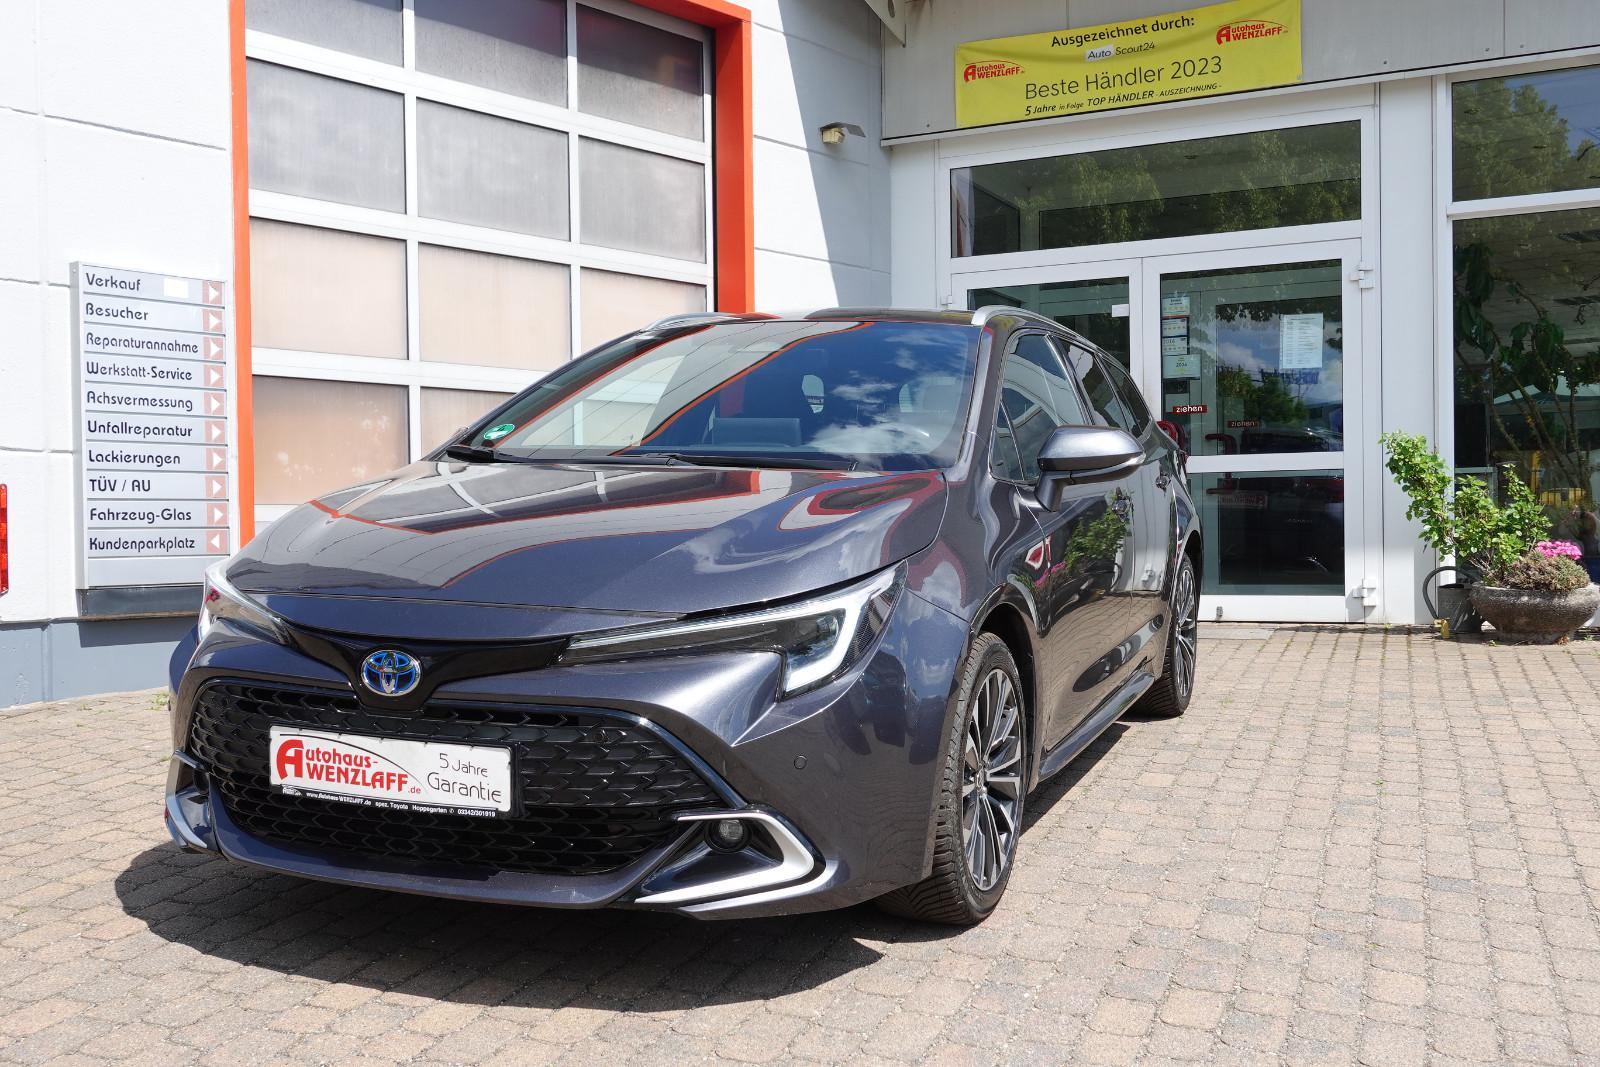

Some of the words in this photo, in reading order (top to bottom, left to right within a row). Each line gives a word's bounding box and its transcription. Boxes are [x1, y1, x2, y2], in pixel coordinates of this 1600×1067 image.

[1051, 23, 1148, 47] Ausgezeichnet
[1151, 15, 1195, 32] durch:
[1216, 23, 1265, 46] Autohaus
[1231, 26, 1283, 41] WENZLAFF
[1087, 49, 1112, 60] Auto
[1115, 41, 1156, 56] Scout24
[964, 63, 1006, 83] Autohaus
[977, 66, 1021, 79] WENZLAFF
[1025, 79, 1080, 100] Beste
[1085, 66, 1165, 92] Händler
[1170, 55, 1222, 80] 2023
[1025, 105, 1032, 117] 5
[1033, 103, 1057, 114] Jahre
[1059, 103, 1066, 111] in
[1066, 101, 1084, 110] Folge
[1087, 97, 1107, 107] TOP
[1108, 90, 1155, 104] HÄNDLER
[1159, 82, 1218, 97] AUSZEICHNUNG
[85, 272, 141, 291] Verkauf
[85, 302, 149, 320] Besucher
[86, 332, 199, 354] Reparaturannahme
[86, 361, 193, 381] Werkstatt-Service
[87, 391, 193, 412] Achsvermessung
[1176, 405, 1203, 413] ziehen
[87, 420, 193, 438] Unfallreparatur
[88, 450, 181, 467] Lackierungen
[89, 476, 117, 492] TÜV
[131, 479, 151, 492] AU
[90, 508, 192, 524] Fahrzeug-Glas
[89, 537, 195, 553] Kundenparkplatz
[439, 752, 449, 769] 5
[452, 759, 488, 777] Jahre
[427, 772, 502, 804] Garantie
[390, 802, 409, 811] Toyota
